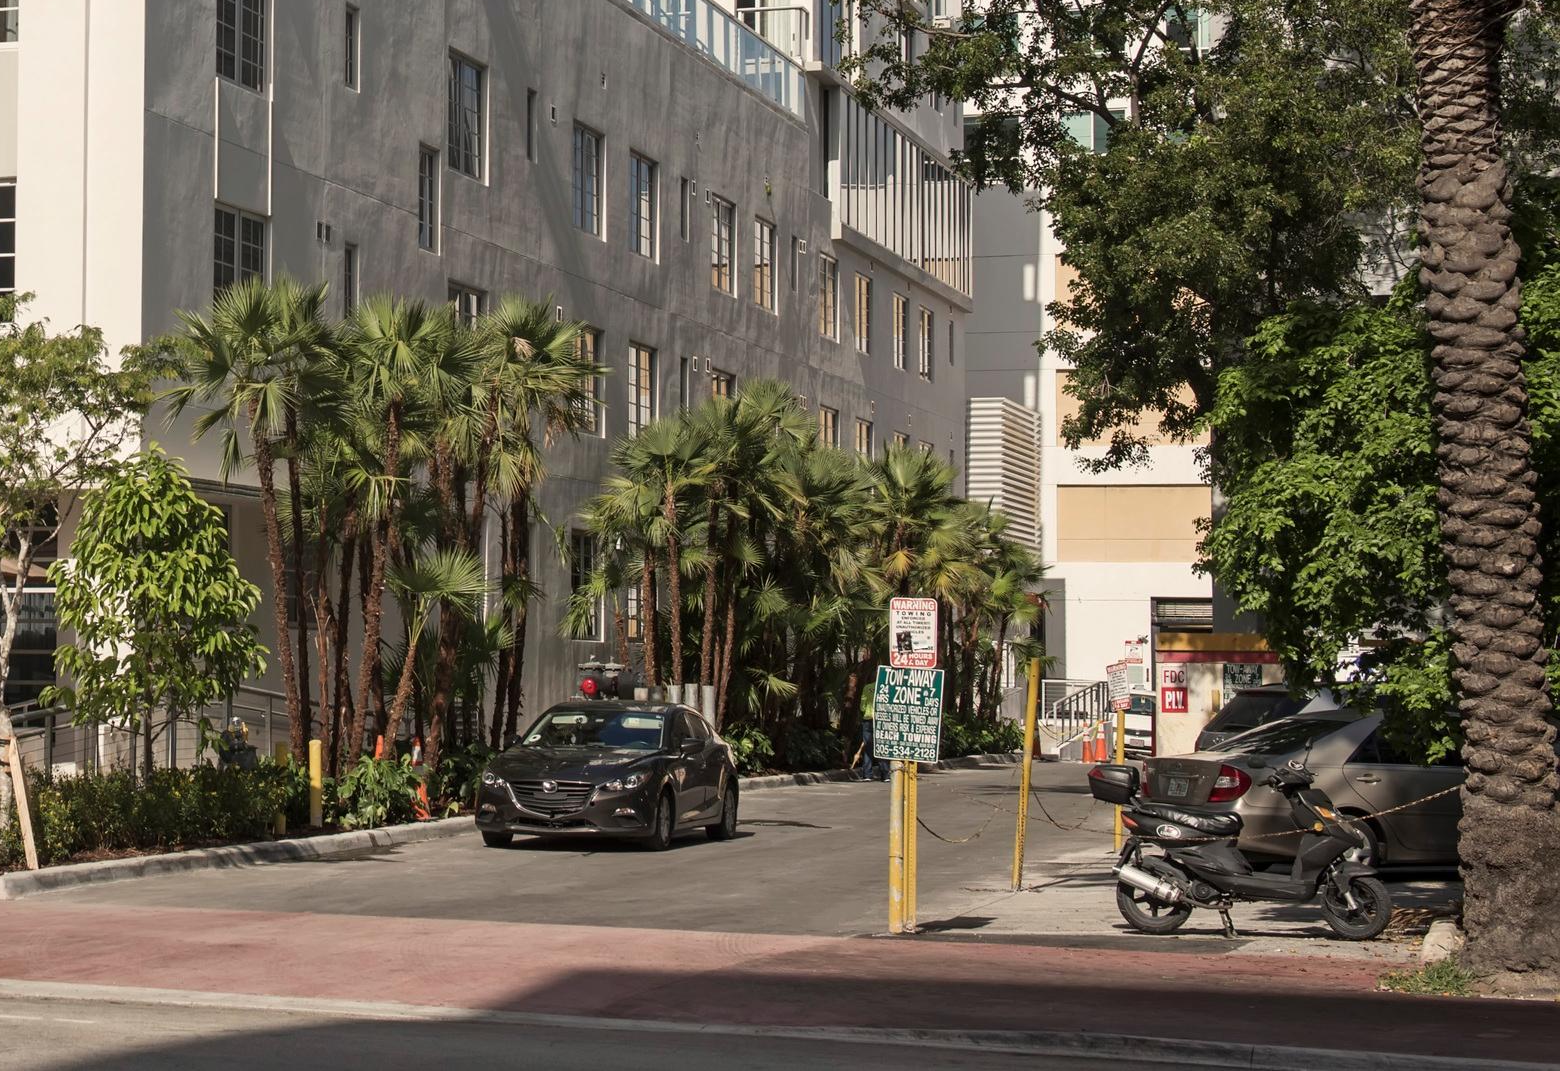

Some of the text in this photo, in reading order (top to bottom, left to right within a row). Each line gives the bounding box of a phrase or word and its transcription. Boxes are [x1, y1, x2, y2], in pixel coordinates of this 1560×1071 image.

[893, 600, 935, 611] WARNING
[894, 653, 908, 665] 24
[1227, 664, 1258, 674] TOW-AWAY
[885, 668, 936, 688] TOW-AWAY
[1164, 670, 1185, 683] FDC
[1235, 674, 1251, 683] ZONE
[876, 693, 939, 707] HRS DAYS
[880, 684, 936, 704] 24 ZONE 7
[876, 703, 938, 716] UNAUTHORIZED VEHICLES OR
[876, 730, 899, 740] BEACH
[903, 732, 937, 744] TOWING
[875, 744, 936, 758] 305-534-2128
